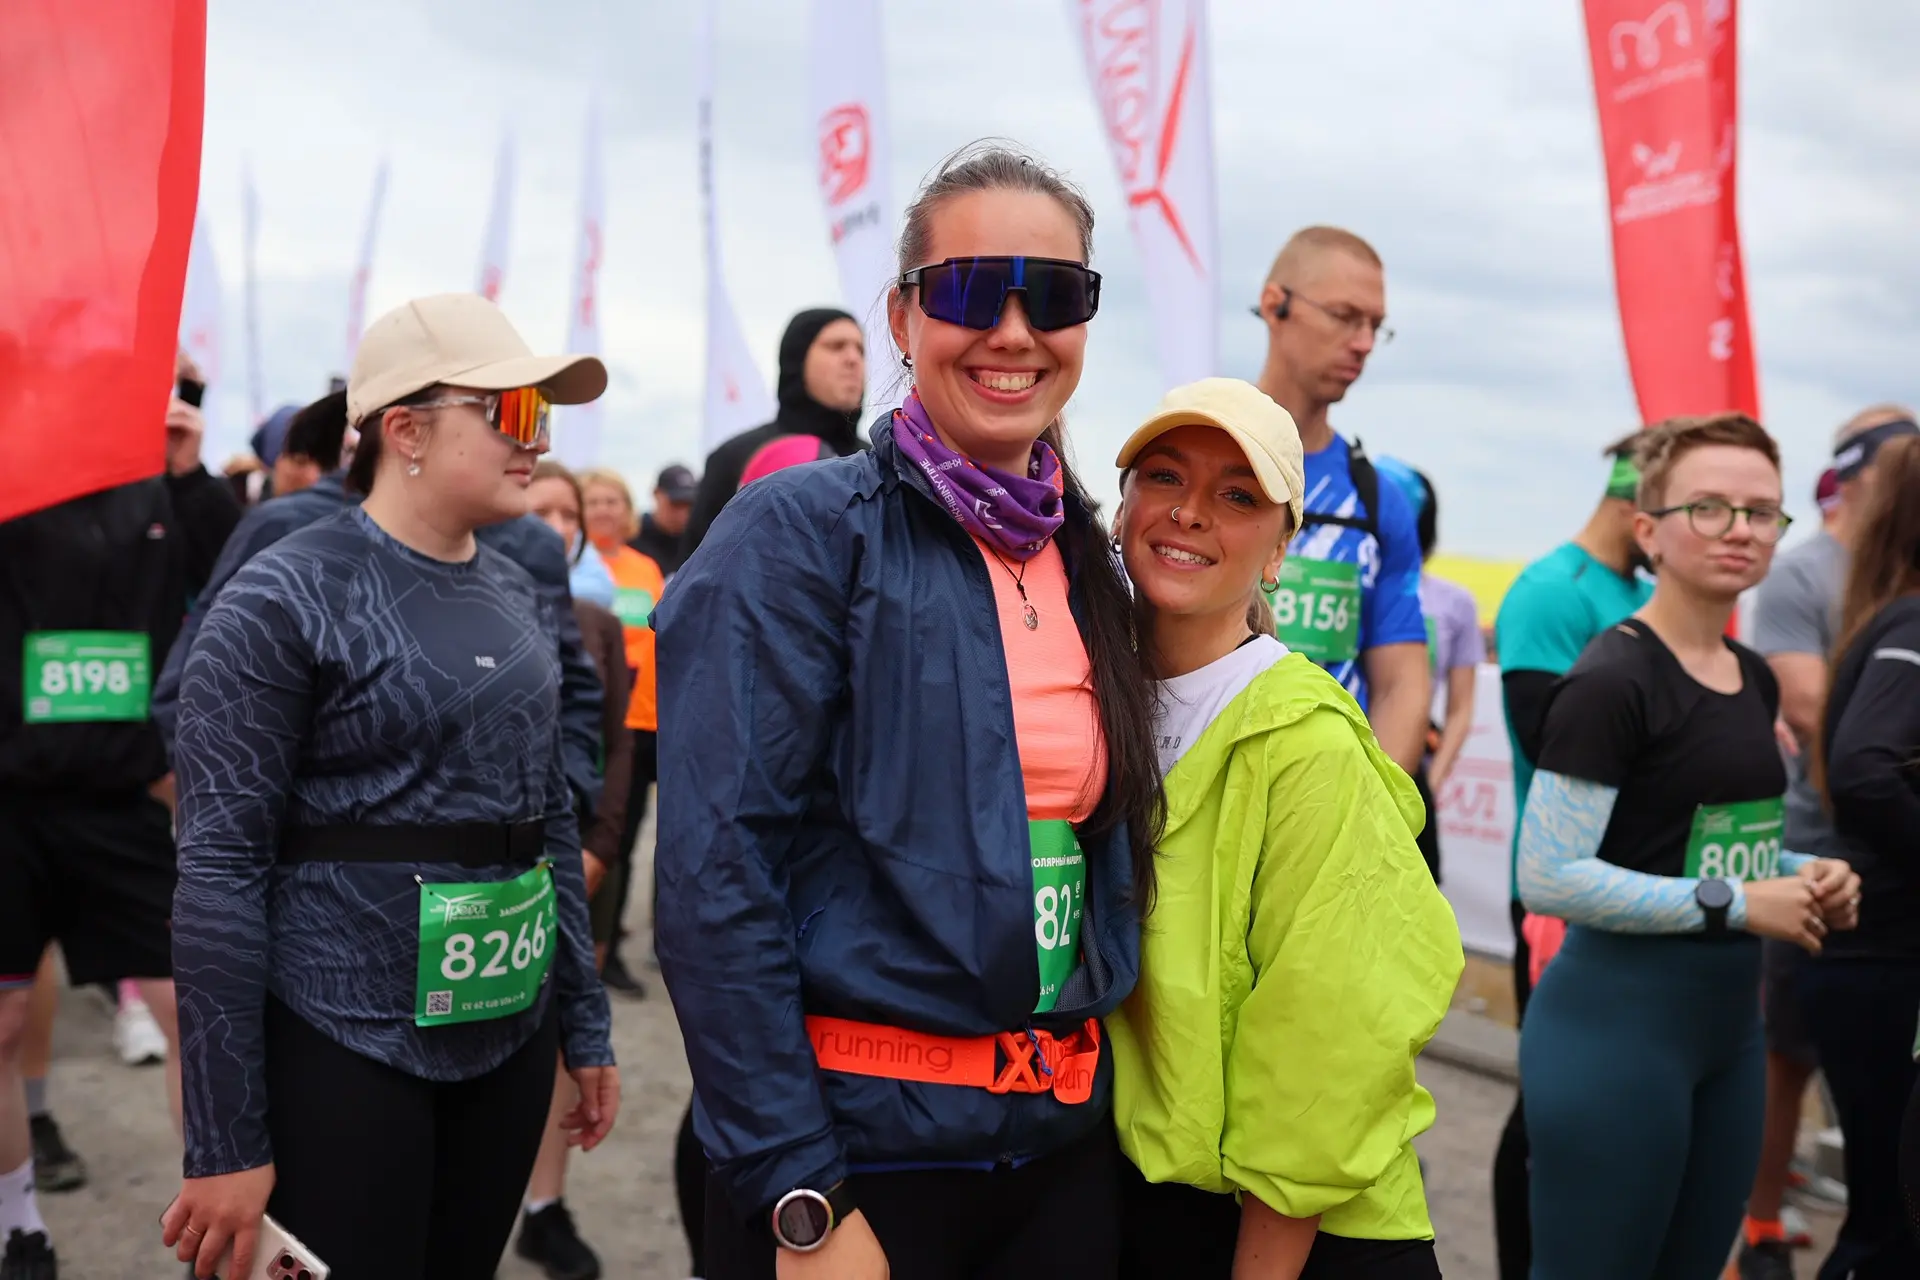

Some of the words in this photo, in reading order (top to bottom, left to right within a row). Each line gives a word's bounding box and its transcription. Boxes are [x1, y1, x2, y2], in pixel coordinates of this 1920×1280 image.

[919, 458, 964, 523] #KHIBINYTIME
[1273, 588, 1349, 632] 8156
[41, 660, 131, 695] 8198
[440, 911, 546, 981] 8266
[818, 1030, 953, 1073] running
